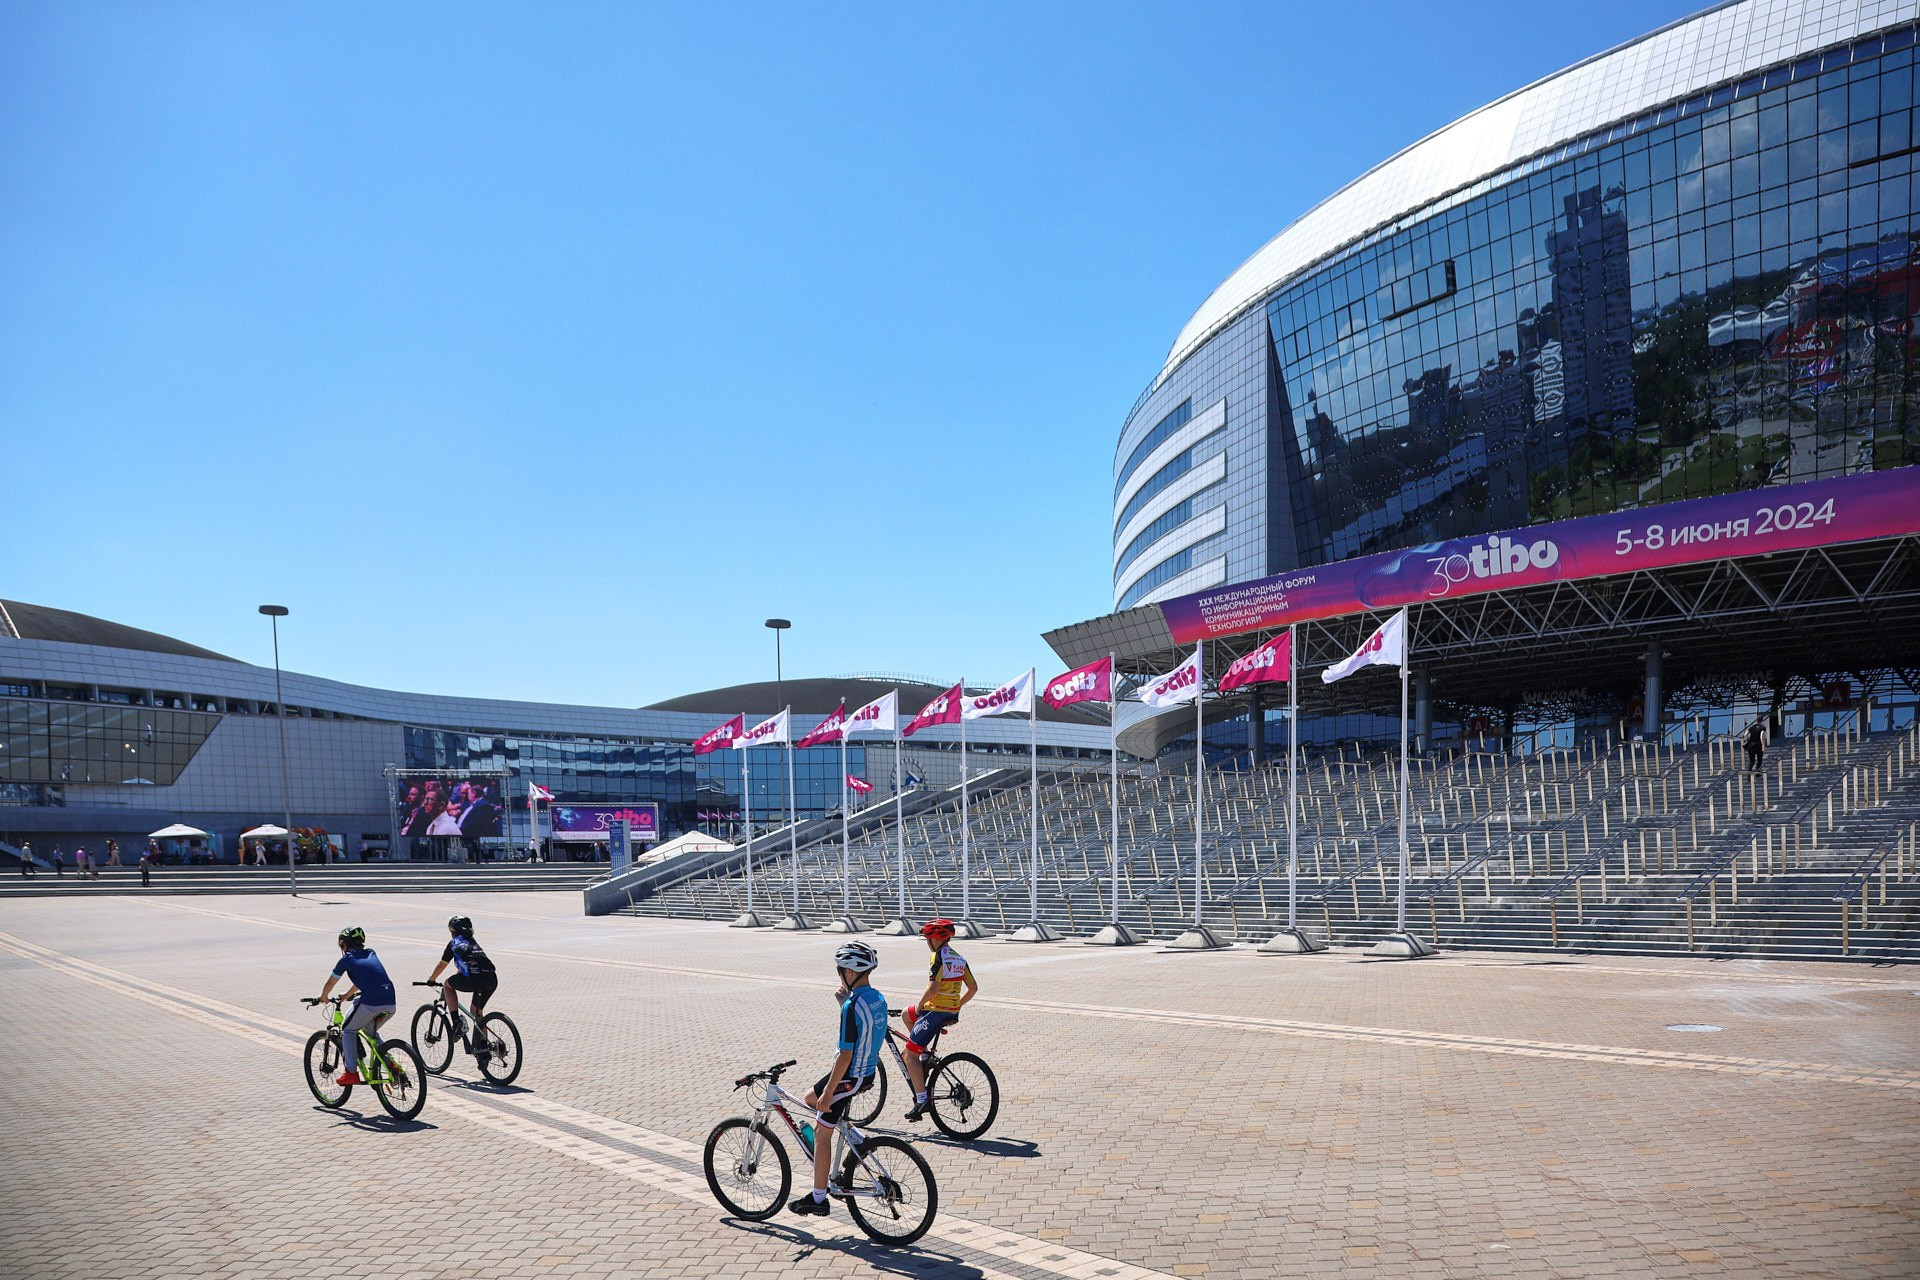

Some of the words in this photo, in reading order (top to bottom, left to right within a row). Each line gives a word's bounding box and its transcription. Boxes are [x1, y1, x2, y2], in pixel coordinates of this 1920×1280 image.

[1615, 524, 1664, 555] 5-8
[1670, 518, 1750, 546] июня
[1754, 498, 1836, 535] 2024
[1468, 535, 1559, 578] tibo
[1213, 580, 1284, 605] МЕЖДУНАРОДНЫЙ
[1285, 575, 1316, 589] ФОРУМ
[1201, 607, 1213, 616] ПО
[1213, 593, 1287, 613] ИНФОРМАЦИОННО-
[1204, 601, 1289, 624] КОММУНИКАЦИОННЫМ
[1208, 615, 1263, 633] ТЕХНОЛОГИЯМ
